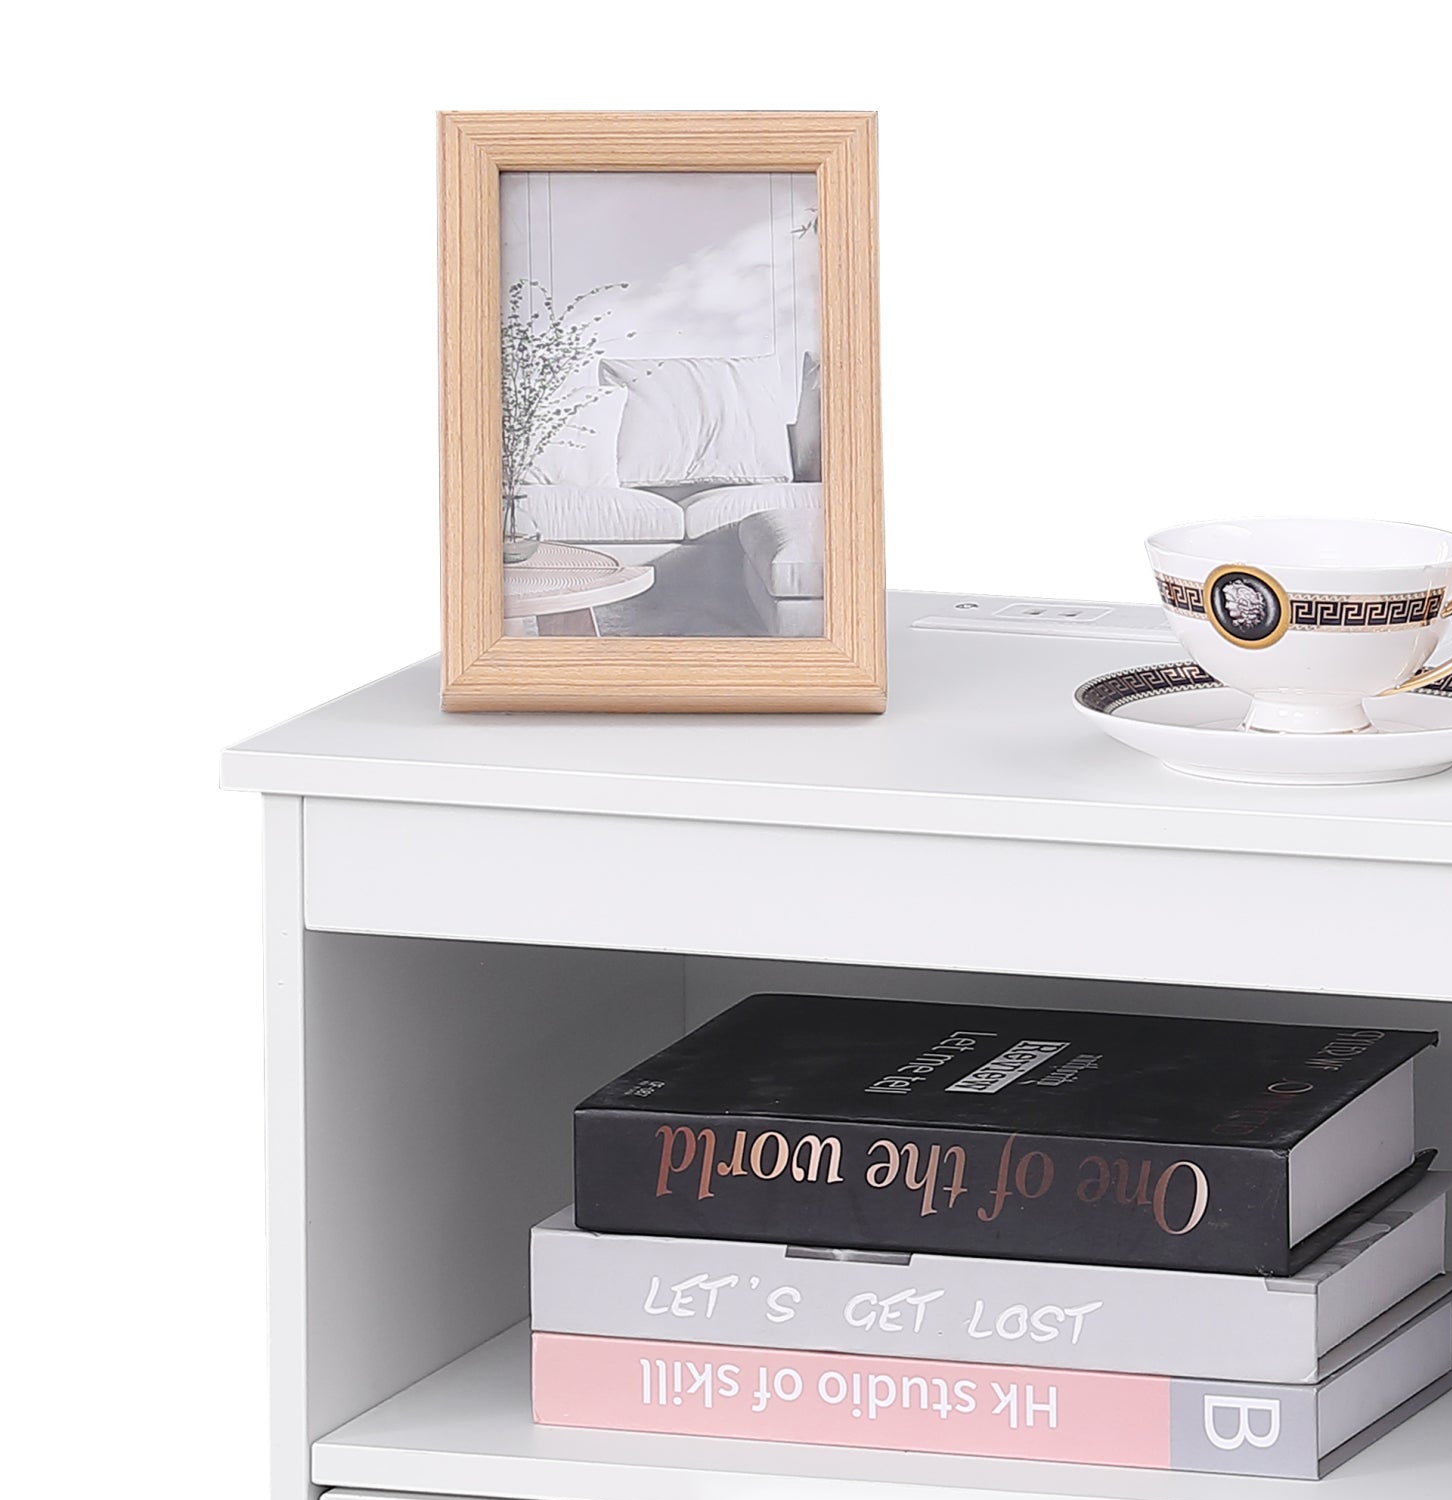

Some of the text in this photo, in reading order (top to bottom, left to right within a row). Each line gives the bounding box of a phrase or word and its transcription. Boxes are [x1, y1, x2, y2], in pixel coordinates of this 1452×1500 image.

[864, 1031, 998, 1095] Let me tell
[954, 1042, 1066, 1091] Review
[655, 1124, 1210, 1236] One of the world
[643, 1272, 1104, 1345] LET'S GET LOST
[639, 1357, 1060, 1430] Hk studio of skill
[1202, 1393, 1281, 1452] B
